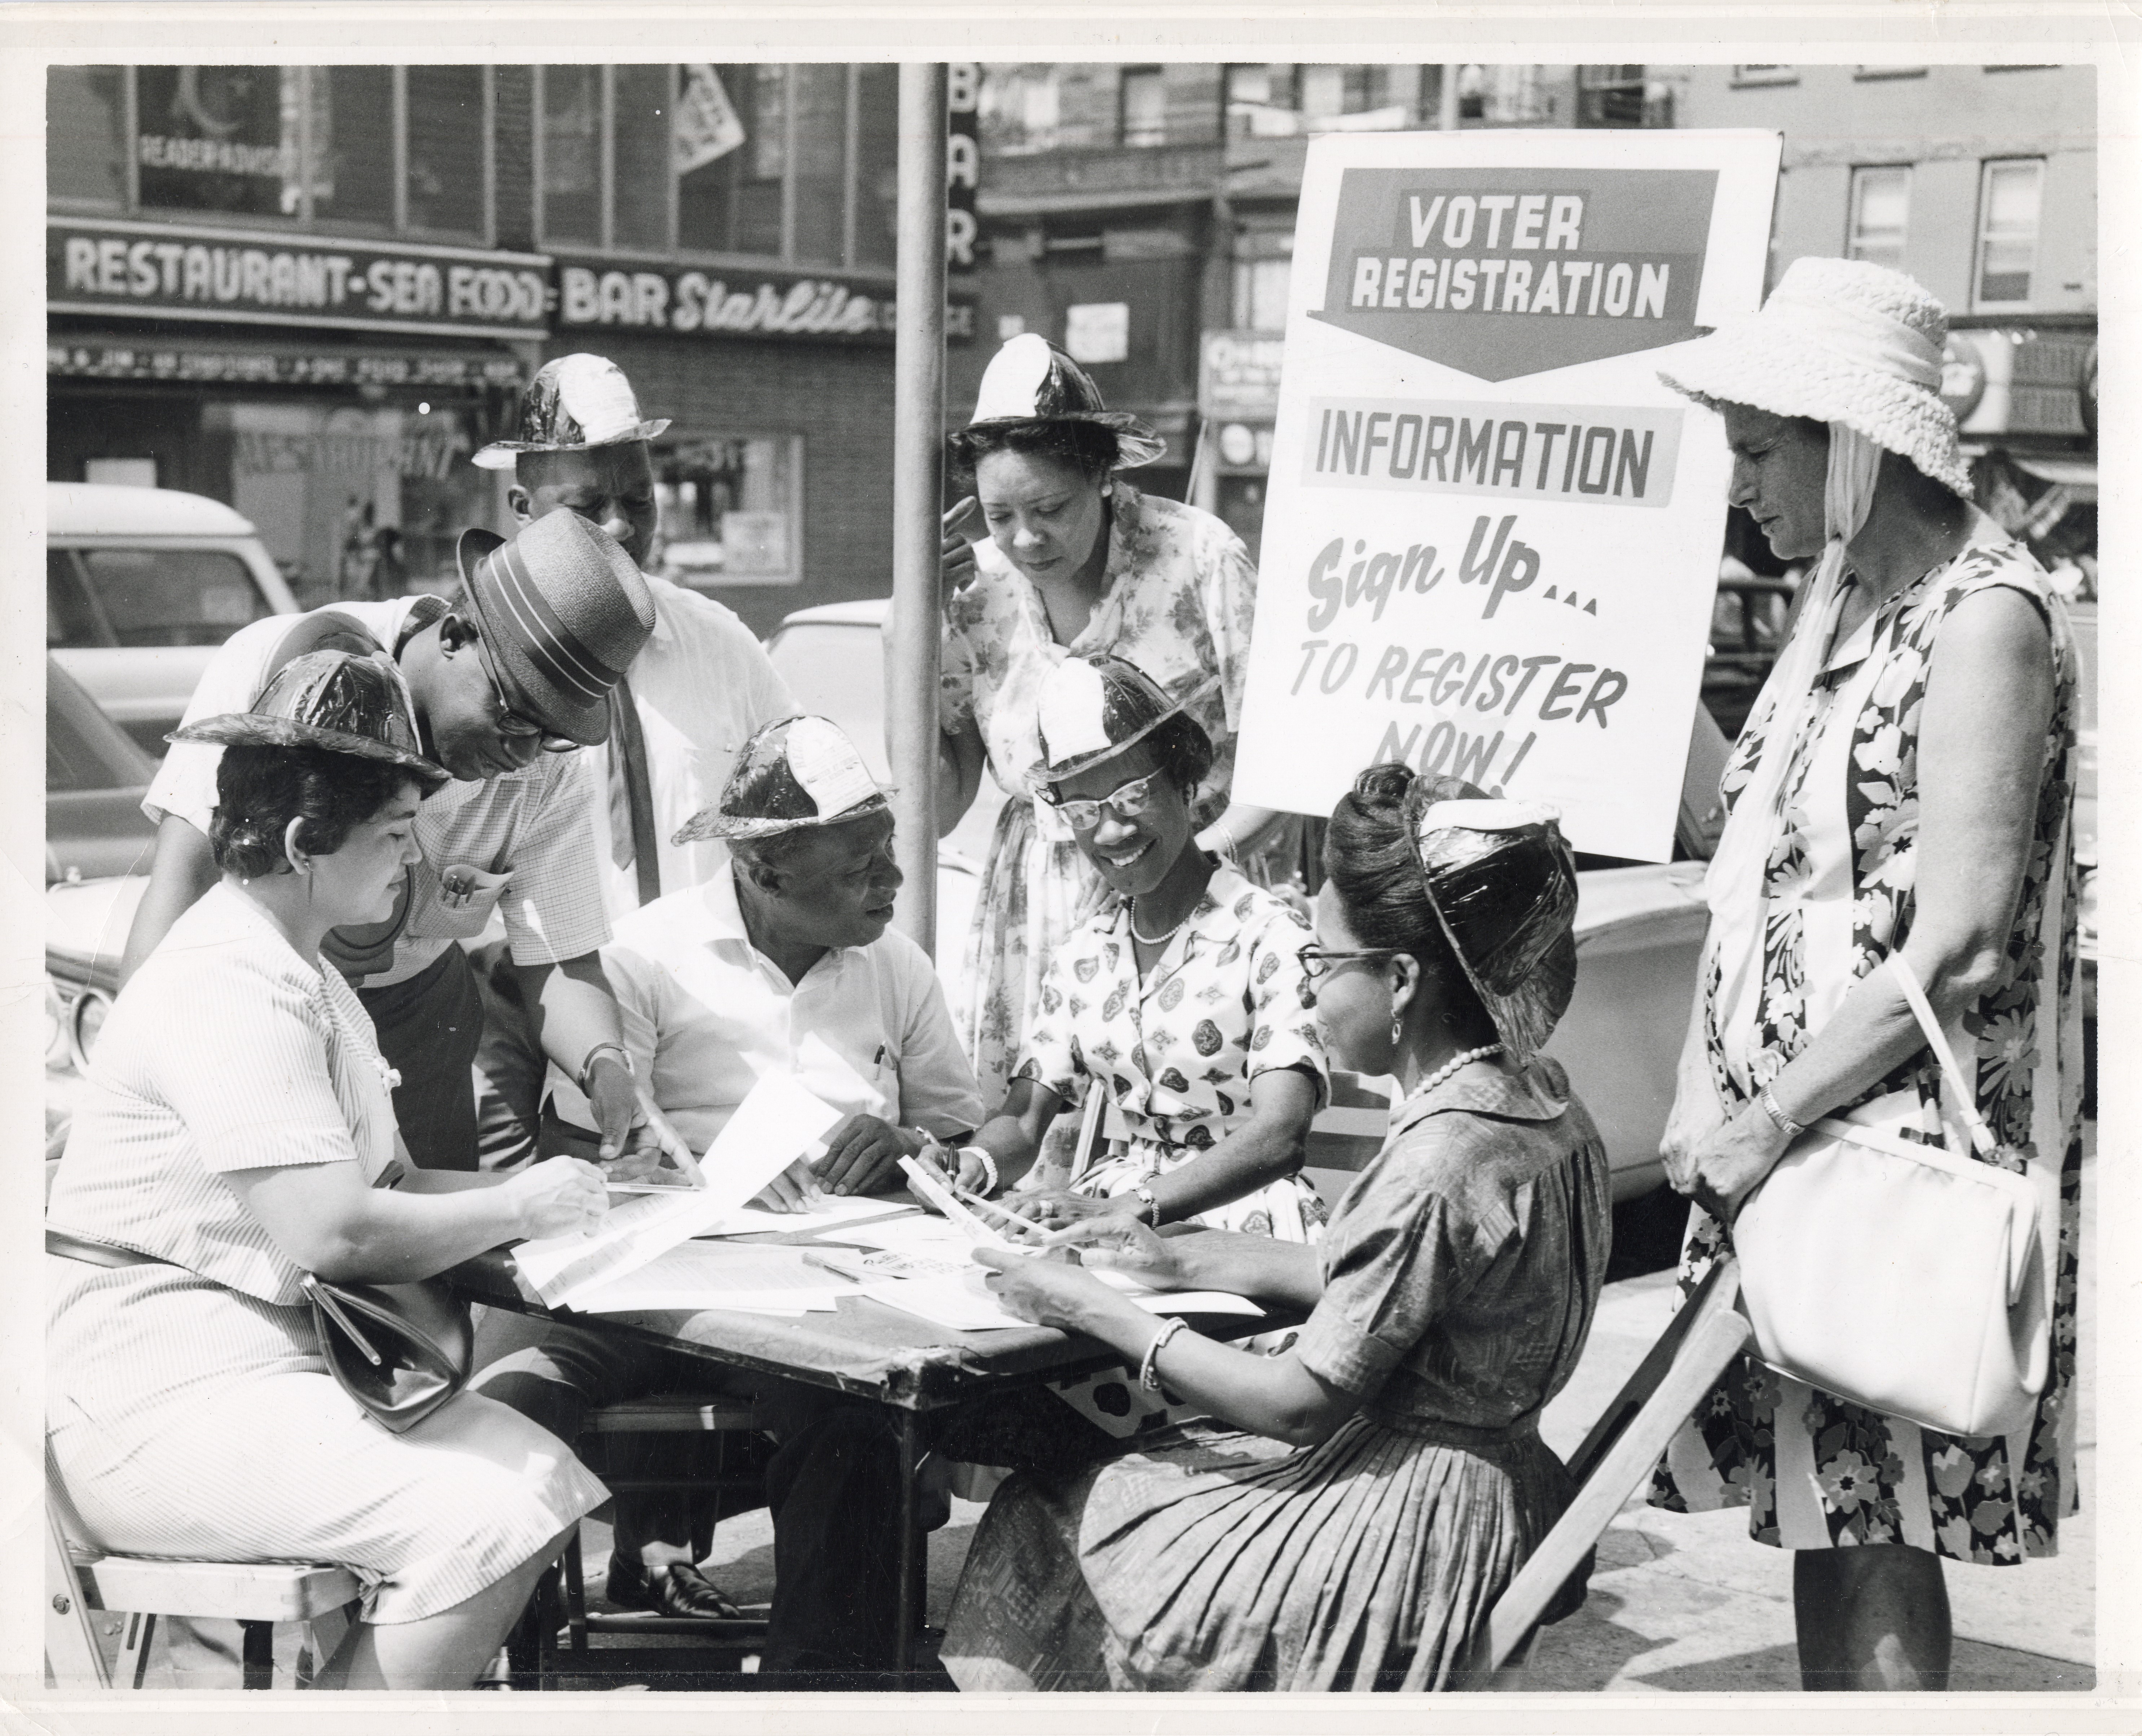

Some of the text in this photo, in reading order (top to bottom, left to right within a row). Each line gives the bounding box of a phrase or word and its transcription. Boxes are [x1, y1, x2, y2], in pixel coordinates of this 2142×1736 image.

[947, 62, 978, 265] BAR
[1409, 194, 1584, 250] VOTER
[65, 237, 544, 322] RESTAURANT SEA FOOD
[561, 267, 671, 328] BAR
[1351, 256, 1670, 319] REGISTRATION
[1315, 409, 1654, 498] INFORMATION
[1307, 537, 1444, 632] Sign
[1290, 639, 1628, 729] TO REGISTER
[1371, 720, 1538, 798] NOW!
